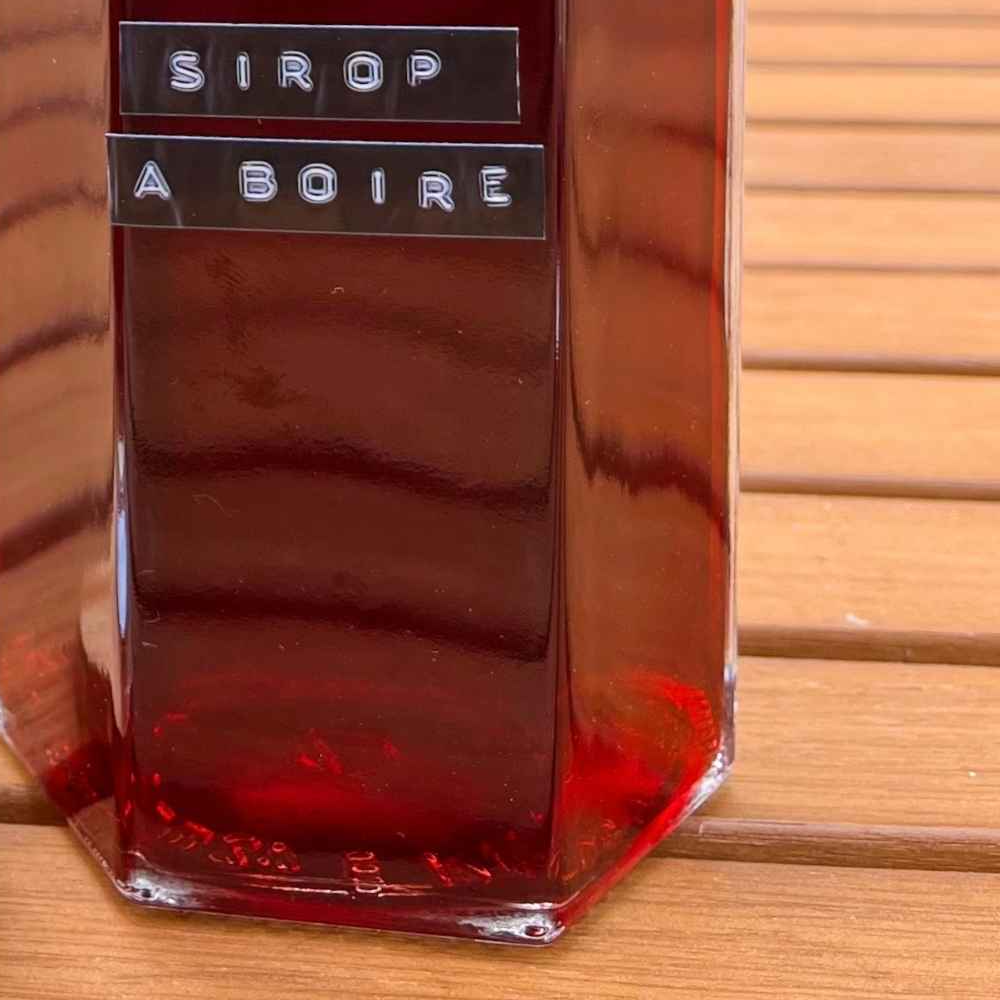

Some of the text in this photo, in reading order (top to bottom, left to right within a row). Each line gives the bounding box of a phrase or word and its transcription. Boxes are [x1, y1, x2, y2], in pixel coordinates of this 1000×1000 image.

[169, 50, 441, 93] SIROP
[133, 160, 513, 213] A BOIRE
